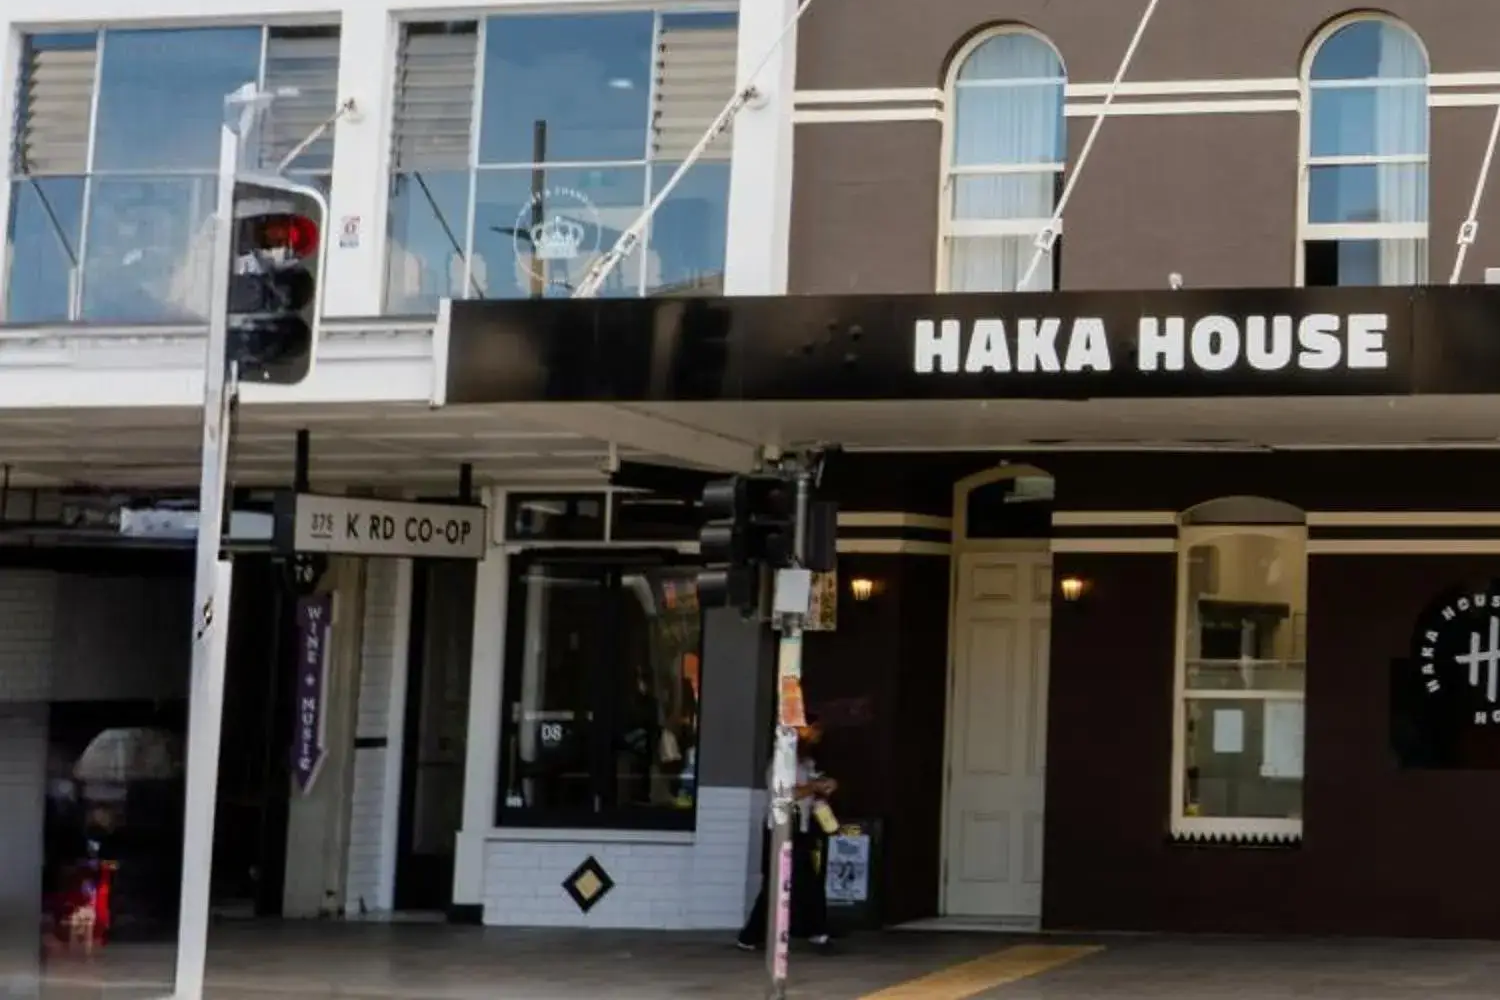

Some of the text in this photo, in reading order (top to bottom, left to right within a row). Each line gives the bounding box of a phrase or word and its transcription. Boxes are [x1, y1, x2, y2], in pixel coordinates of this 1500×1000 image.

[914, 313, 1388, 373] HAKA HOUSE
[346, 512, 361, 538] K
[369, 514, 395, 540] RD
[405, 516, 472, 544] CO-OP
[306, 606, 323, 664] WINE
[1421, 630, 1441, 693] HAKA
[298, 697, 316, 771] MUSIC
